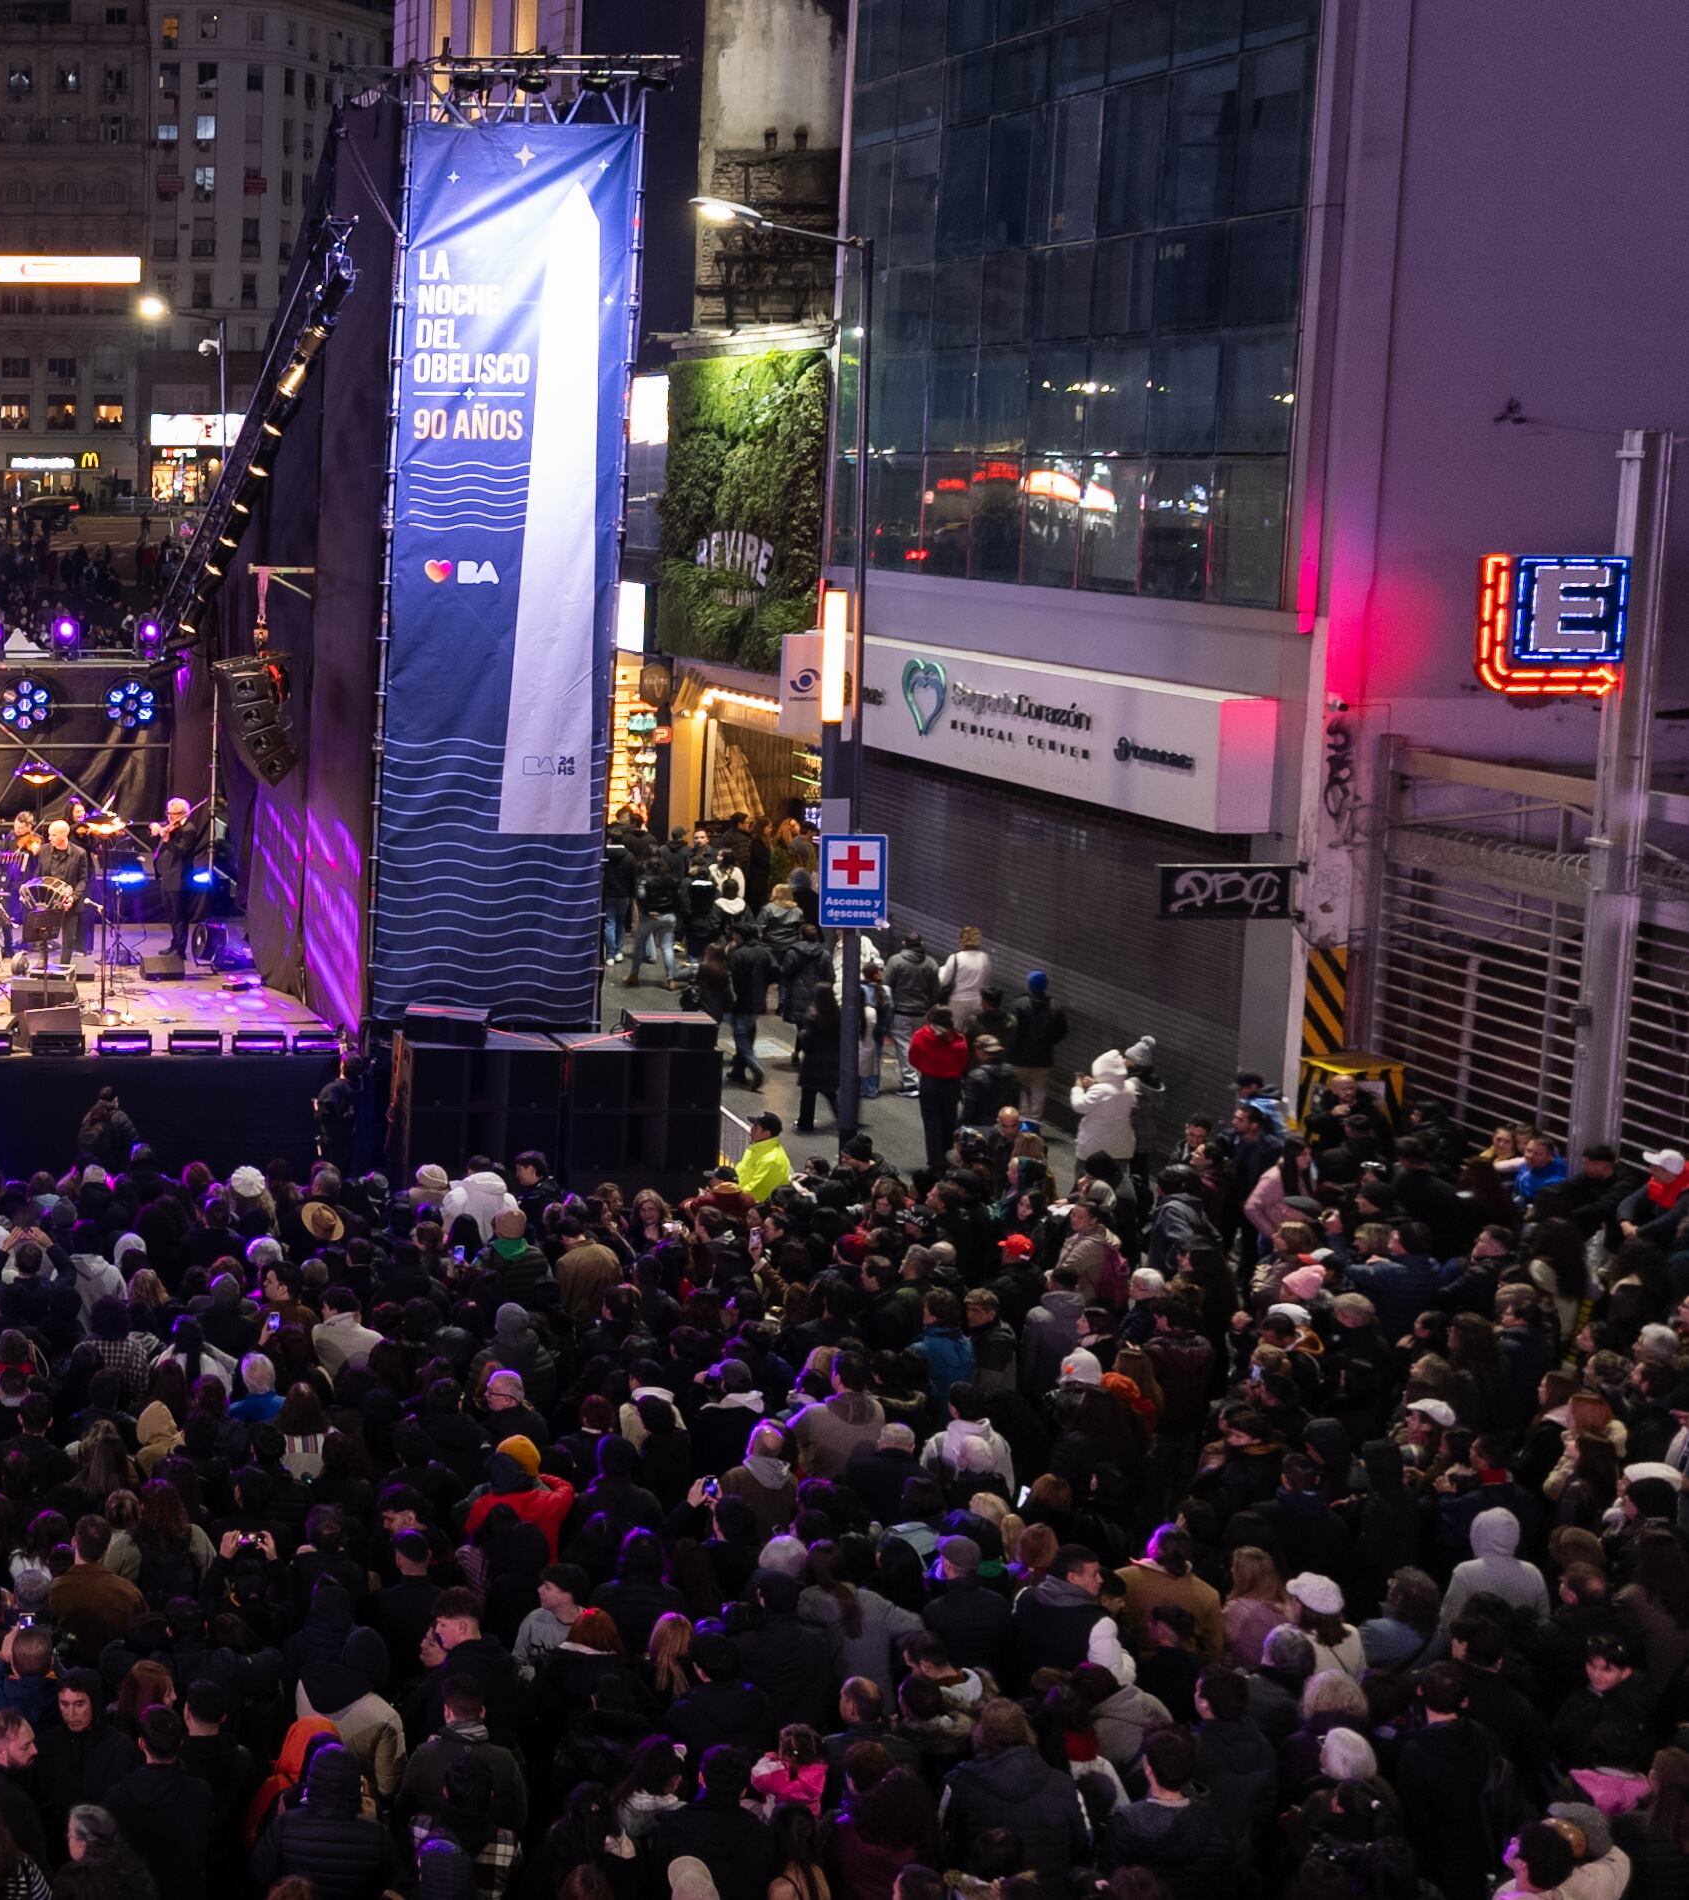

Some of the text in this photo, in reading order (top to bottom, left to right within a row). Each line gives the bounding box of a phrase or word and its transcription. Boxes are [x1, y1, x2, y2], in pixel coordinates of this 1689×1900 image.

[419, 249, 450, 280] LA
[418, 284, 501, 315] NOCHE
[415, 319, 461, 349] DEL
[413, 353, 530, 384] OBELISCO
[414, 403, 523, 440] 90 AÑOS
[457, 560, 500, 584] BA
[1529, 565, 1611, 652] E
[558, 766, 575, 775] HS
[559, 756, 575, 765] 24
[825, 896, 881, 909] Ascenso y
[827, 908, 879, 918] descenso
